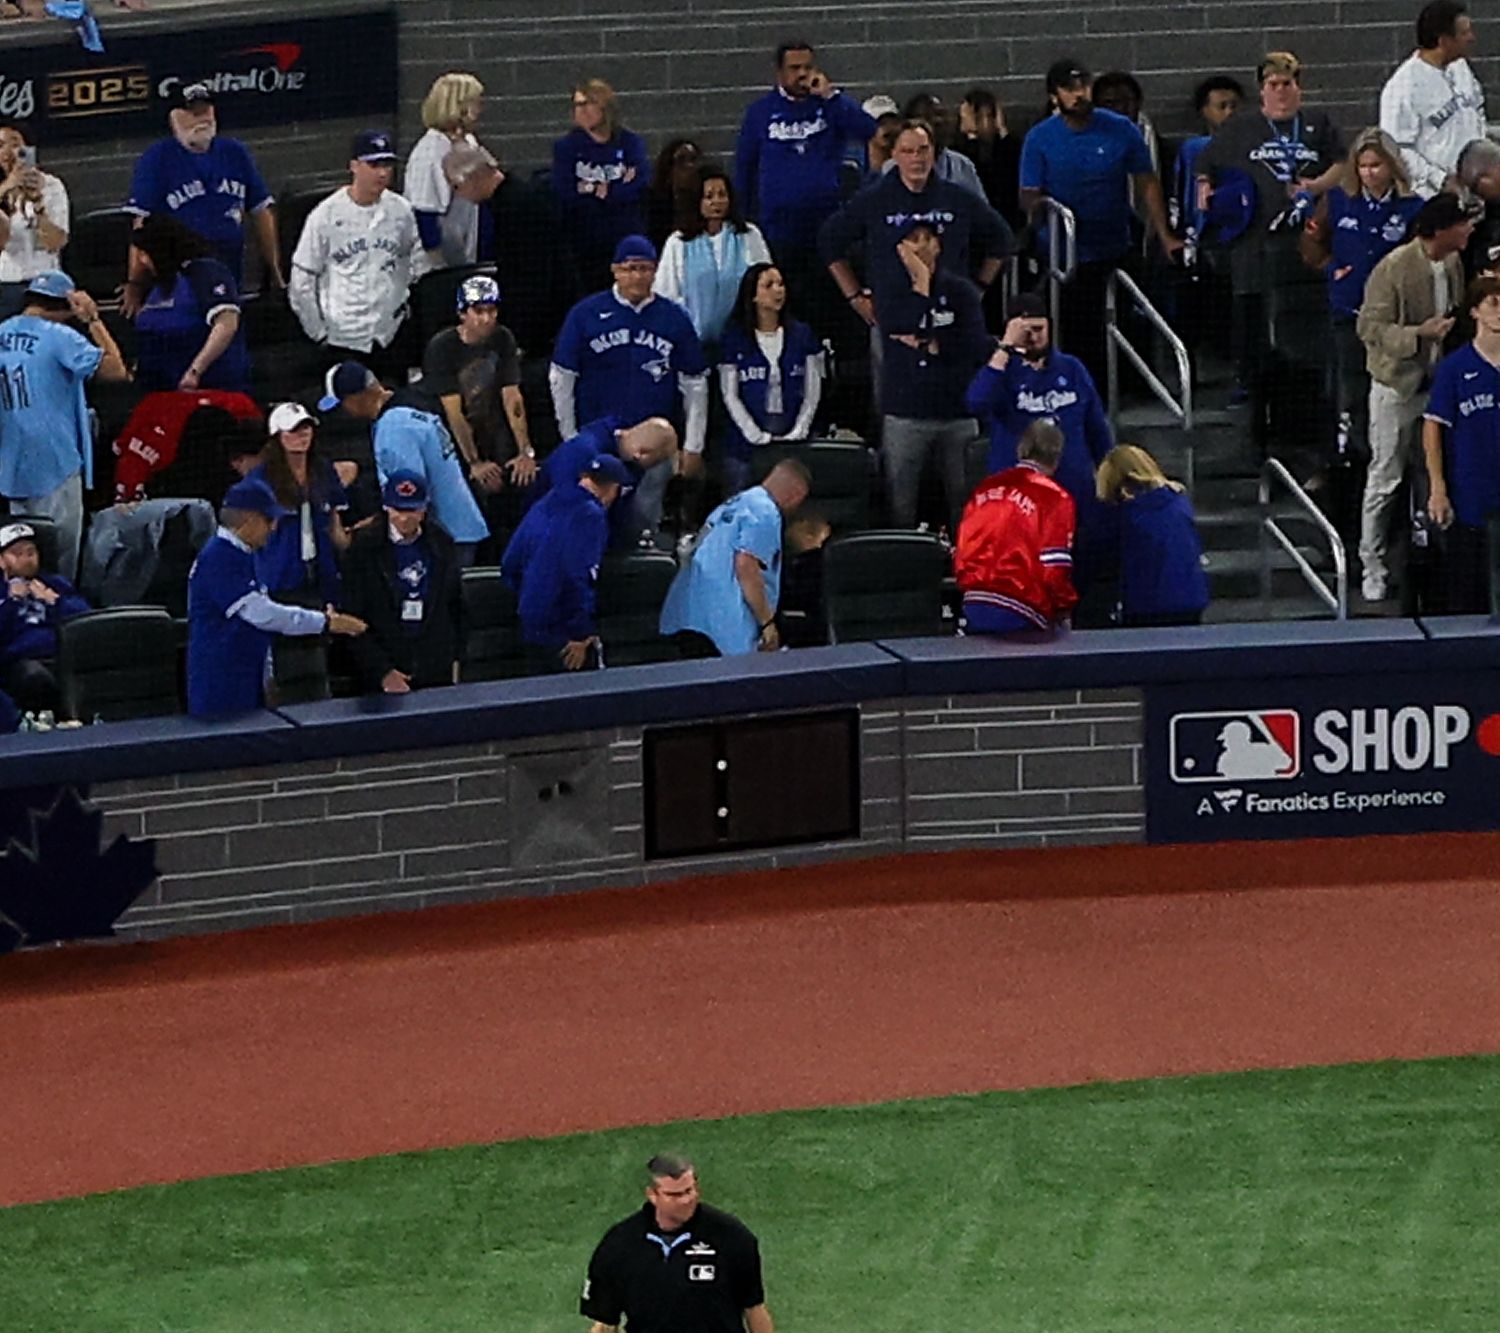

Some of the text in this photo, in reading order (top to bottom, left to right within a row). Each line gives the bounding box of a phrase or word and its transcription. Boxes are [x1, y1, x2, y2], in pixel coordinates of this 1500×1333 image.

[48, 76, 149, 107] 2025
[1313, 705, 1470, 774] SHOP
[1197, 788, 1446, 816] A Fanatics Experience
